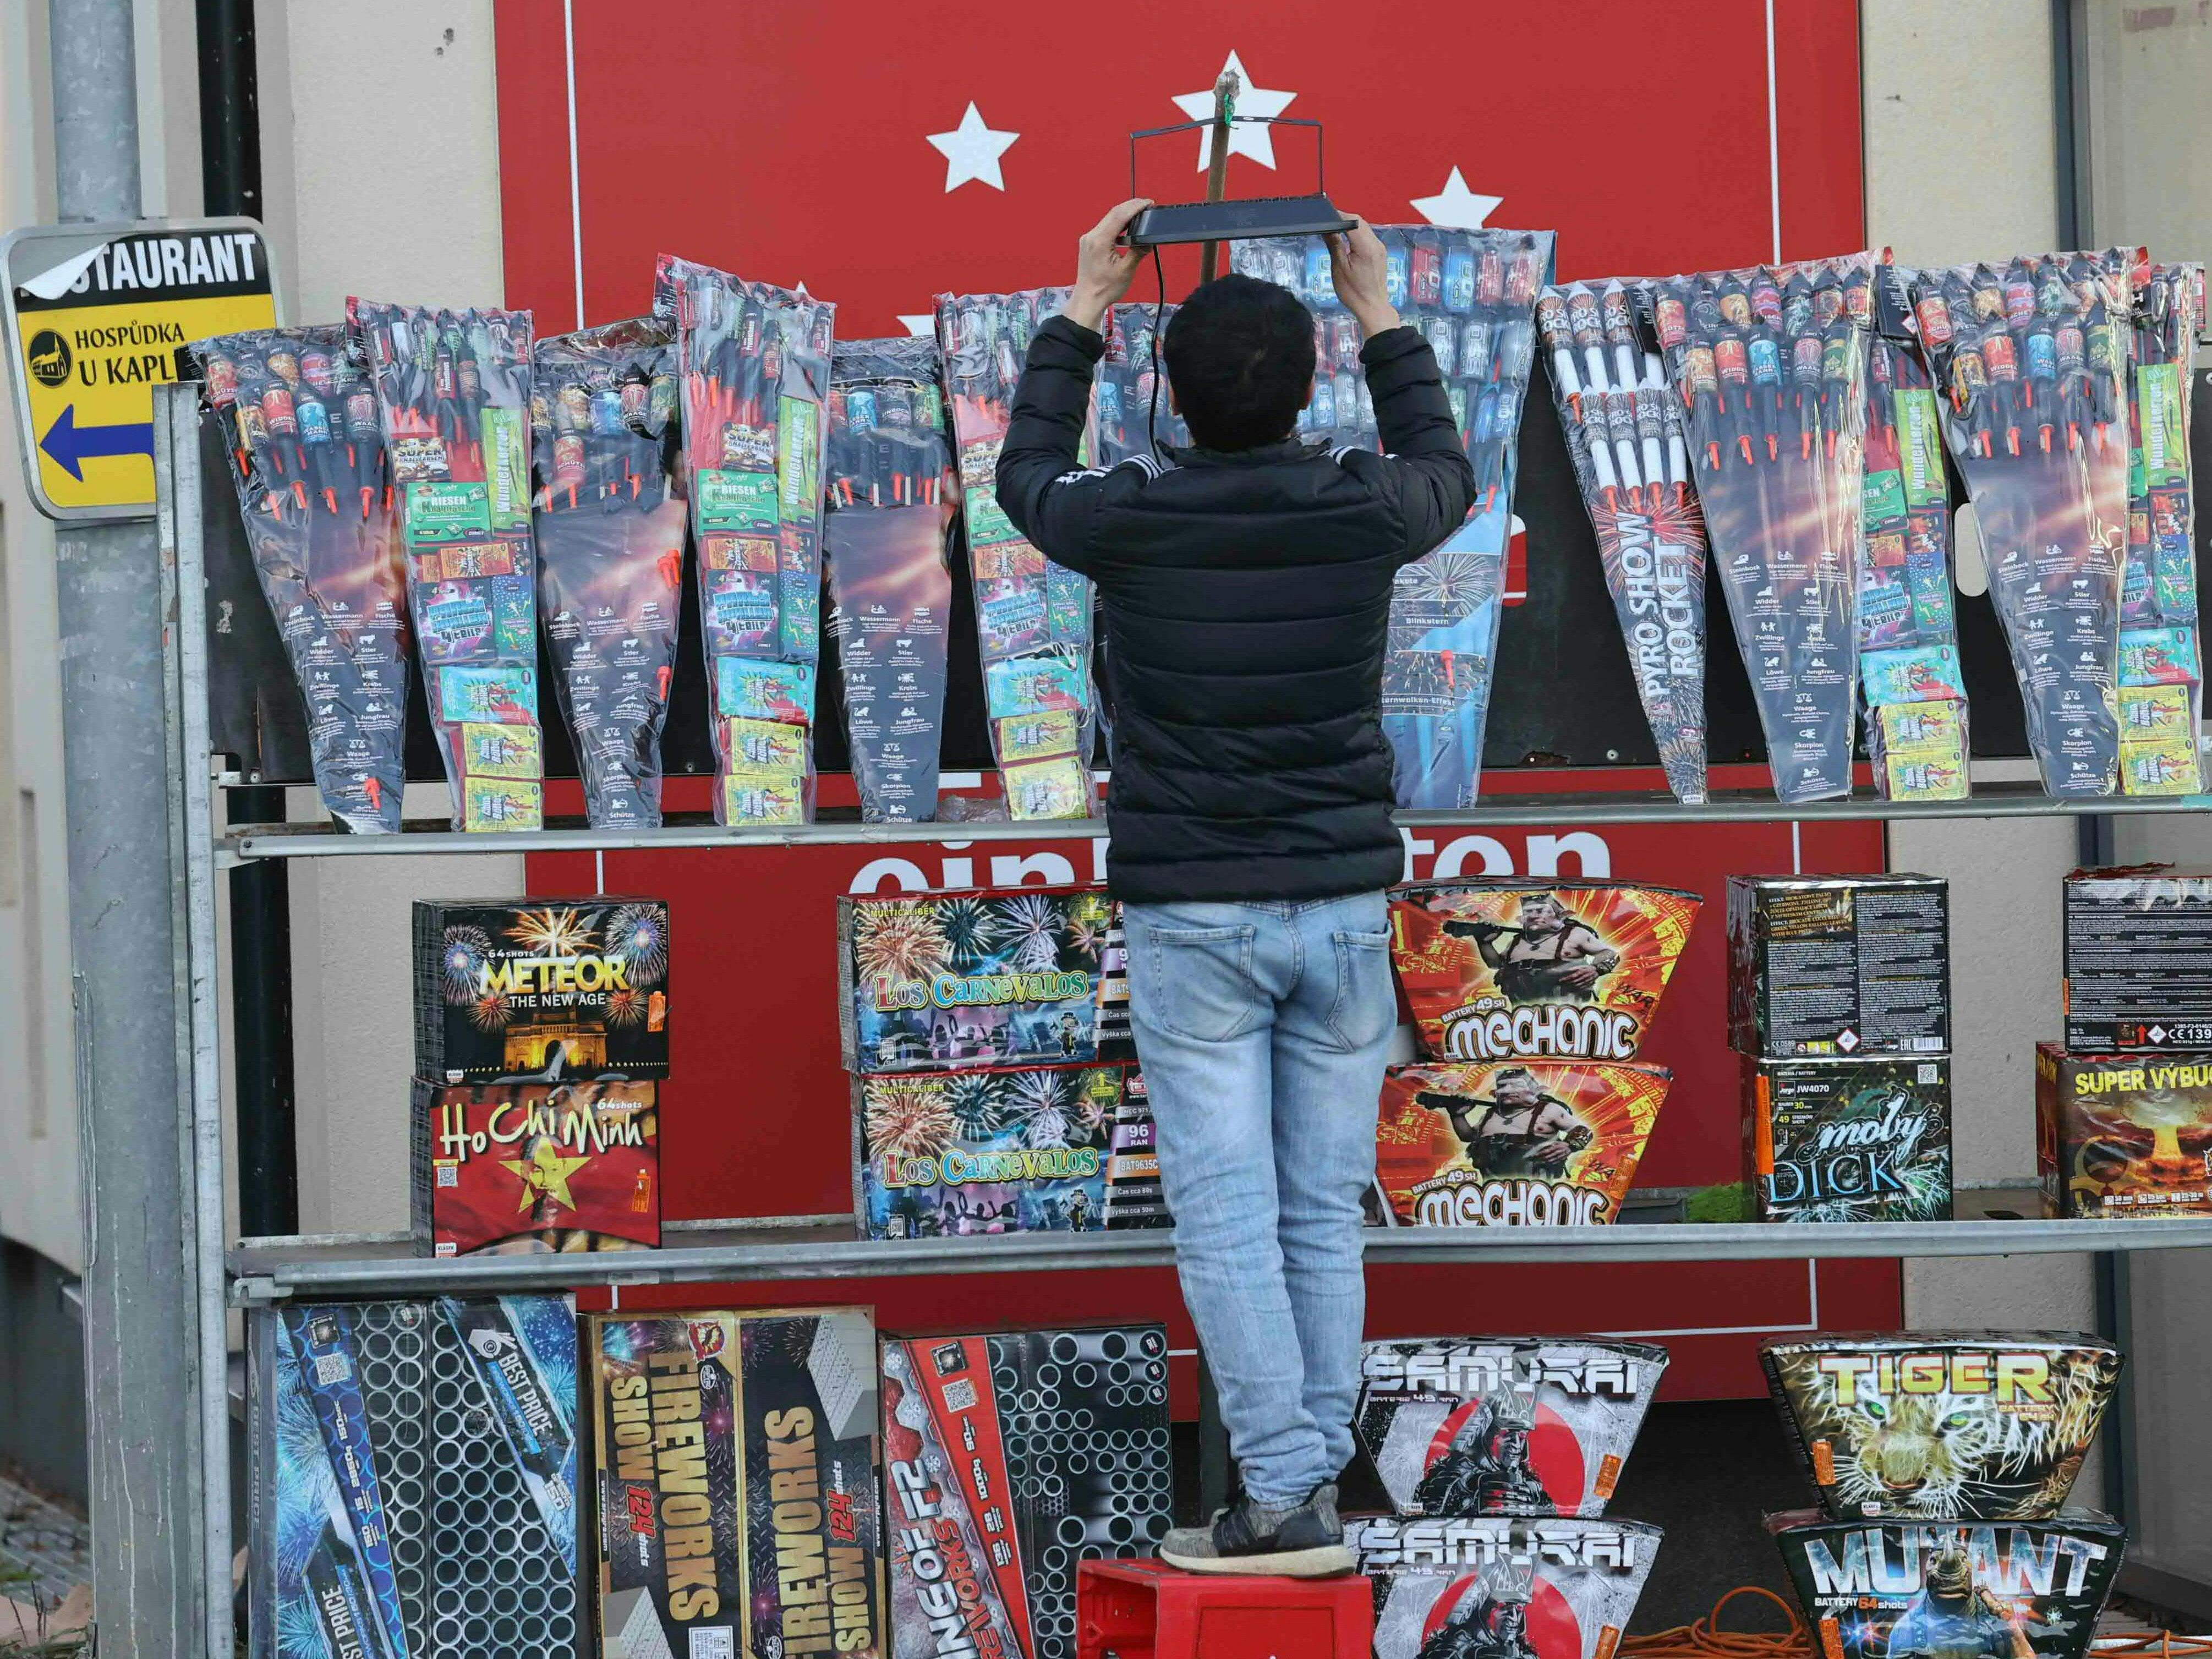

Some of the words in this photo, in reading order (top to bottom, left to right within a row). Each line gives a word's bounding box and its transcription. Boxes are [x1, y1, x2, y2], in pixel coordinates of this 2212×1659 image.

[74, 320, 184, 349] HOSPŮDKA
[79, 360, 97, 387] U
[107, 355, 177, 384] KAPL
[1615, 512, 1658, 616] SHOW
[2034, 556, 2077, 565] Wassermann
[1653, 536, 1699, 677] ROCKET
[1635, 622, 1669, 699] PYRO
[870, 907, 935, 917] MULTICALIBER
[479, 955, 629, 994] METEOR
[509, 995, 536, 1008] THE
[542, 994, 573, 1007] NEW
[578, 993, 606, 1005] AGE
[1442, 1006, 1476, 1022] BATTERY
[1476, 998, 1493, 1011] 49
[1494, 999, 1506, 1008] SH
[879, 1084, 944, 1094] MULTICALIBER
[2075, 1070, 2146, 1095] SUPER
[440, 1104, 487, 1162] Ho
[489, 1100, 555, 1143] Chi
[564, 1104, 643, 1154] Minh
[1129, 1125, 1149, 1137] 96
[1412, 1176, 1447, 1193] BATTERY
[1447, 1170, 1464, 1182] 49
[1465, 1173, 1477, 1181] SH
[1768, 1152, 1902, 1202] DICK
[1364, 1355, 1638, 1393] SAMURAI
[1819, 1352, 2056, 1406] TIGER
[498, 1352, 532, 1390] BEST
[517, 1392, 553, 1436] PRICE
[610, 1376, 655, 1480] SHOW
[345, 1445, 360, 1488] 2850g
[834, 1460, 844, 1494] shots
[973, 1458, 988, 1501] 1000g
[354, 1497, 364, 1510] 15
[649, 1351, 720, 1622] FIREWORKS
[626, 1485, 656, 1539] 124
[827, 1488, 856, 1542] 124
[984, 1512, 995, 1532] 28
[362, 1525, 374, 1548] 150
[638, 1532, 649, 1567] shots
[764, 1405, 831, 1659] IREWORKS
[1361, 1527, 1636, 1567] SAMURAI
[900, 1527, 945, 1580] OF
[992, 1542, 1004, 1567] 136
[321, 1585, 355, 1639] PRICE
[828, 1547, 872, 1651] SHOW
[1815, 1597, 1858, 1607] BATTERY
[1858, 1598, 1877, 1609] 64
